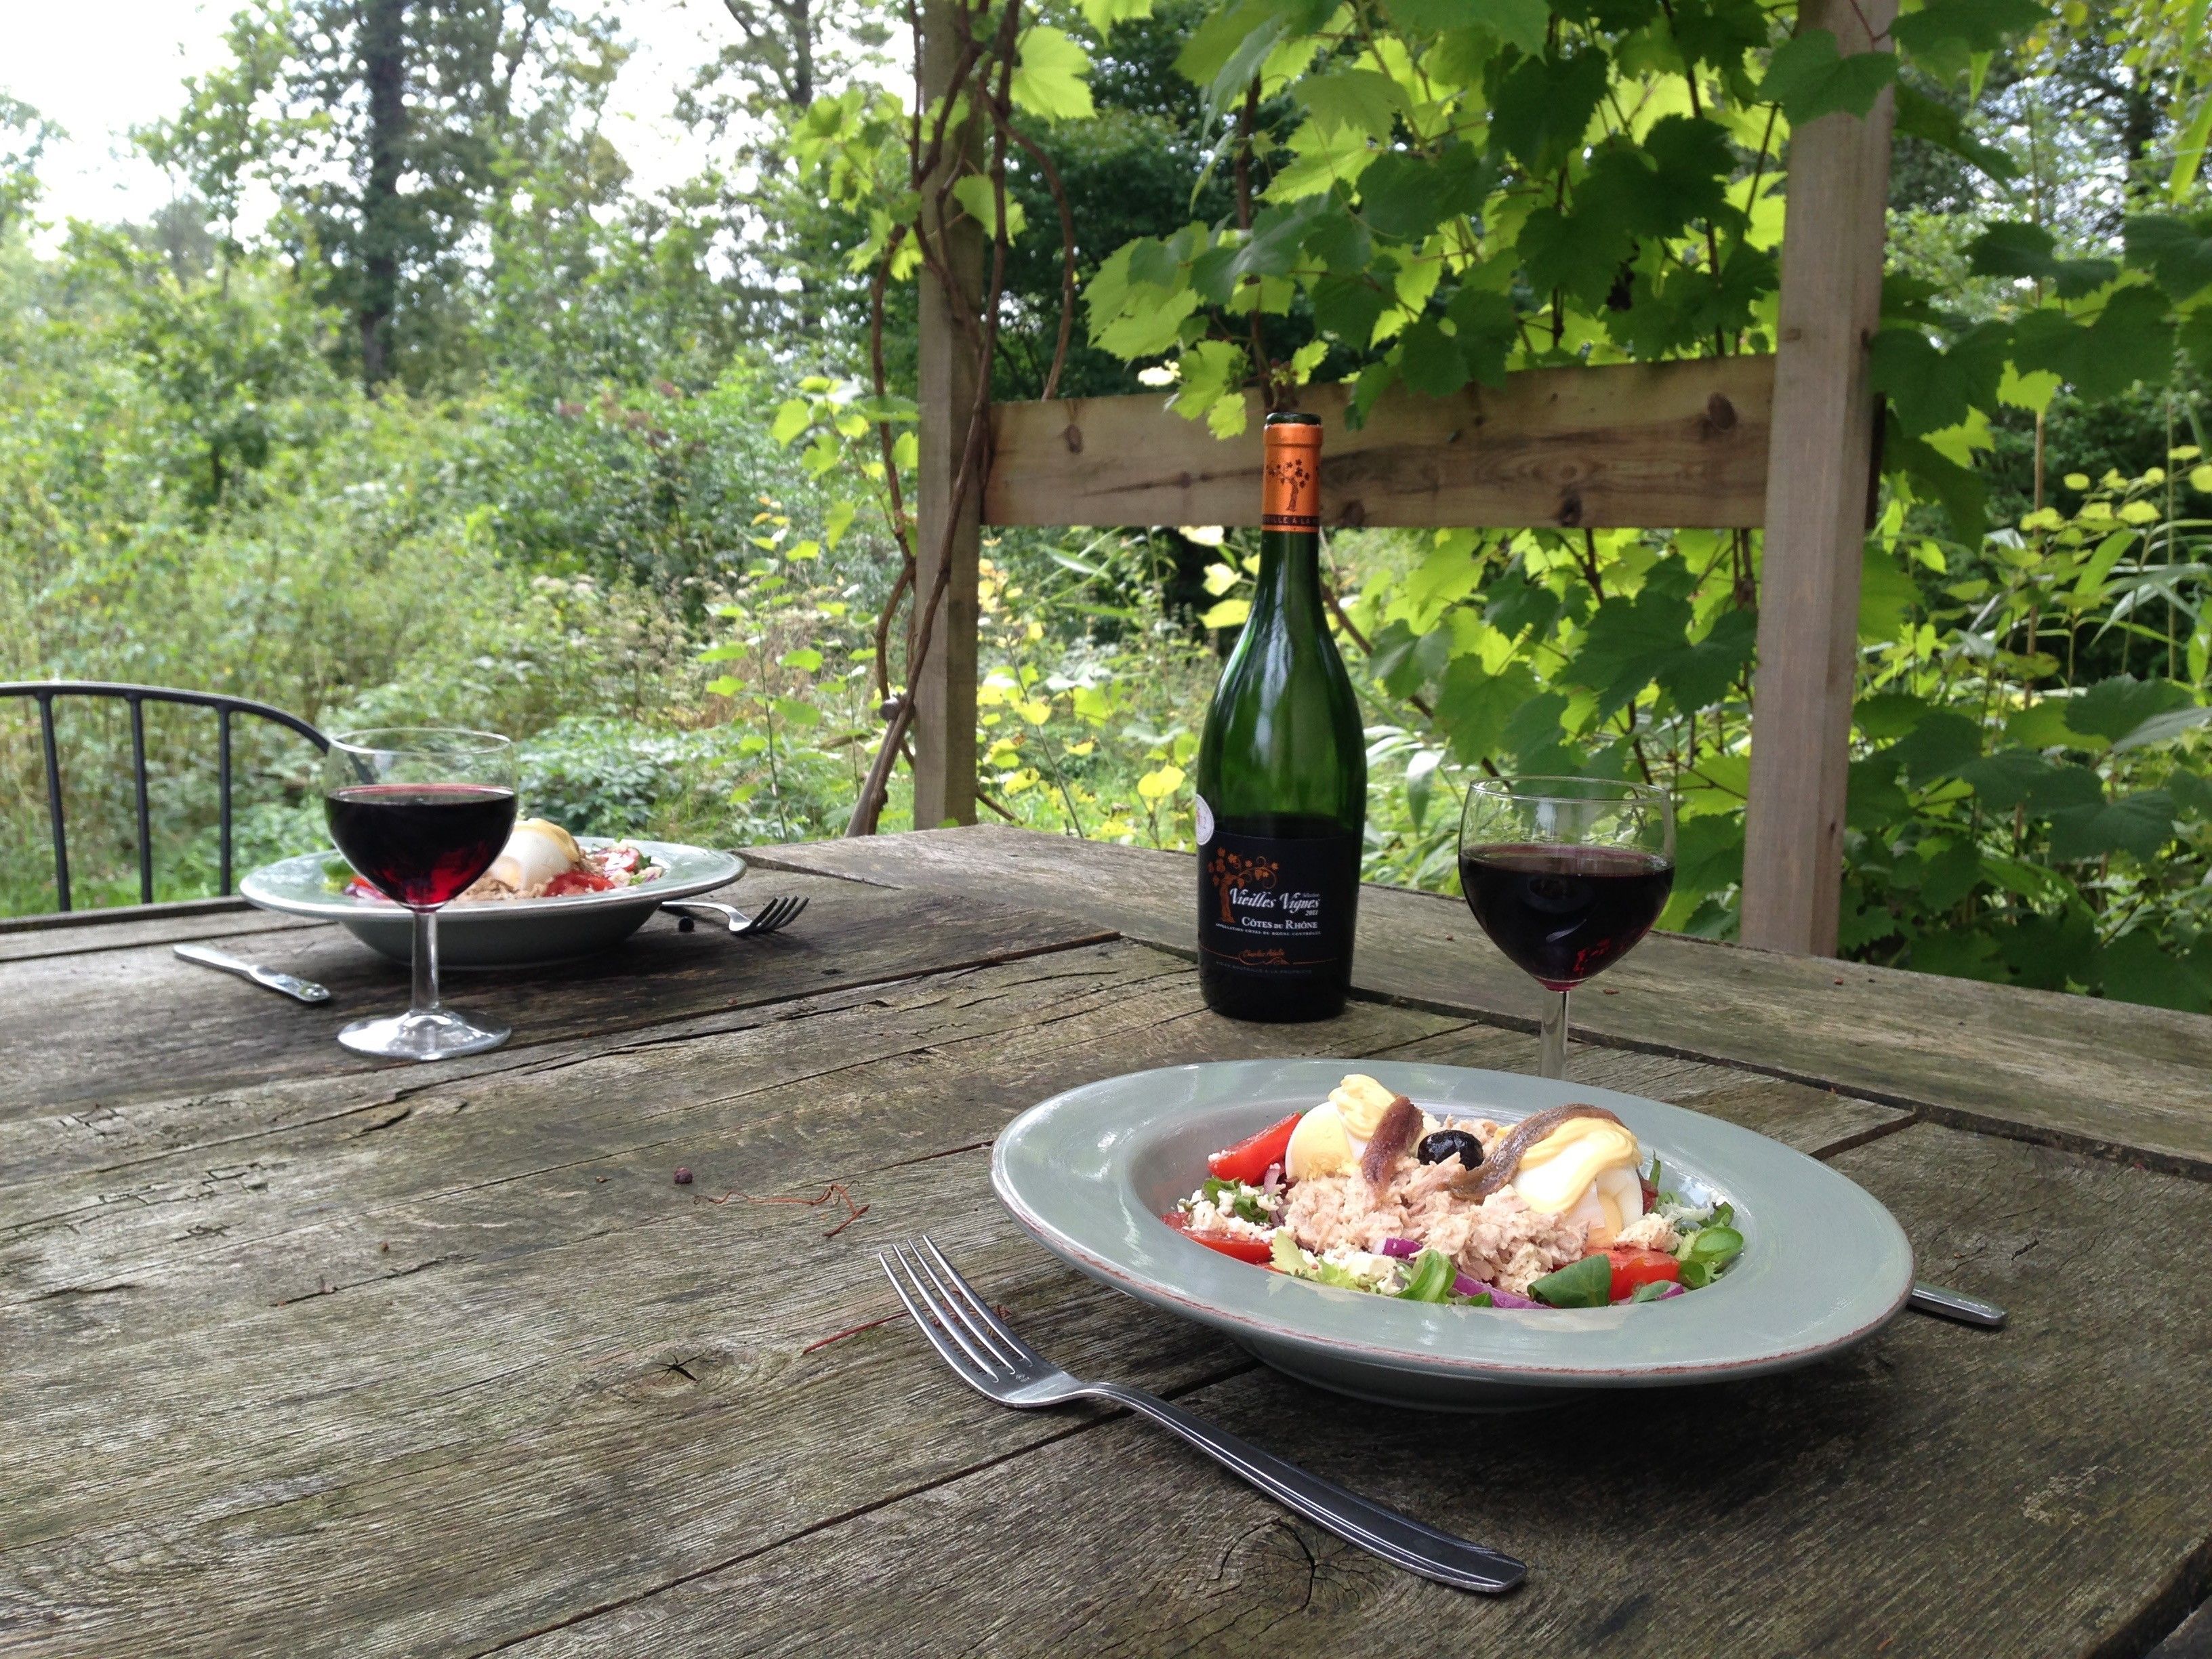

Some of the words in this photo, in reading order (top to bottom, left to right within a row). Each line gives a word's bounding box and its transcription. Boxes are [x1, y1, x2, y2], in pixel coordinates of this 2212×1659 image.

[1229, 888, 1277, 908] Vieilles
[1279, 892, 1320, 914] Vignes
[1242, 916, 1273, 928] CÔTES
[1285, 919, 1318, 929] RHÔNE
